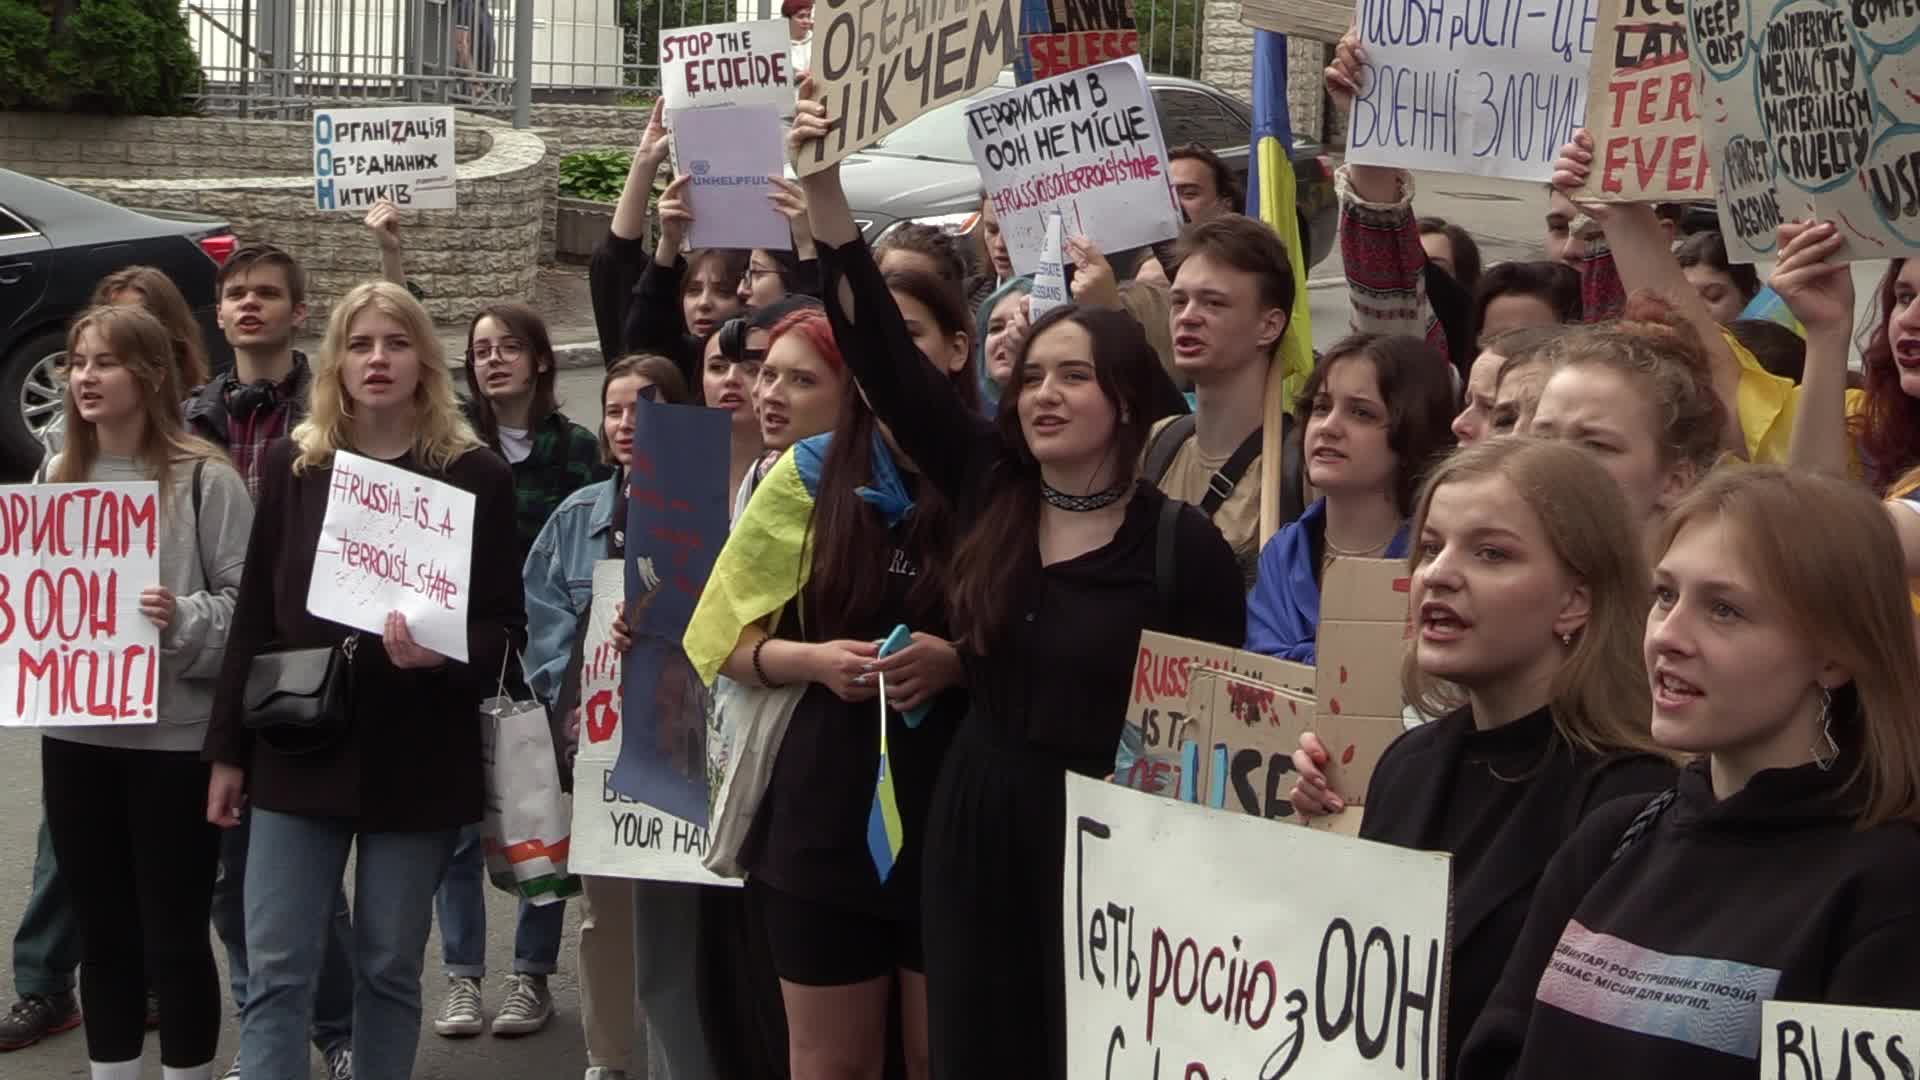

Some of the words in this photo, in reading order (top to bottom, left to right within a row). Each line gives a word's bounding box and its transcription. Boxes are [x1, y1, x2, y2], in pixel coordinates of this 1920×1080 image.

[1693, 0, 1740, 43] KEEP
[663, 31, 713, 63] STOP
[716, 30, 751, 53] THE
[1087, 73, 1108, 107] В
[985, 135, 1030, 171] ООН
[1034, 123, 1070, 161] НЕ
[1777, 128, 1869, 179] CRUELTY
[692, 175, 769, 186] UNHELPFUL
[24, 567, 117, 641] ООН
[1141, 708, 1160, 748] IS
[610, 811, 664, 850] YOUR
[1076, 816, 1140, 1000] Геть
[1146, 926, 1277, 1045] росію
[1316, 917, 1439, 1080] ООН
[1595, 974, 1636, 996] МІСЦЯ
[1635, 987, 1662, 1002] ДЛЯ
[1701, 979, 1757, 1003] ІЛЮЗІЙ
